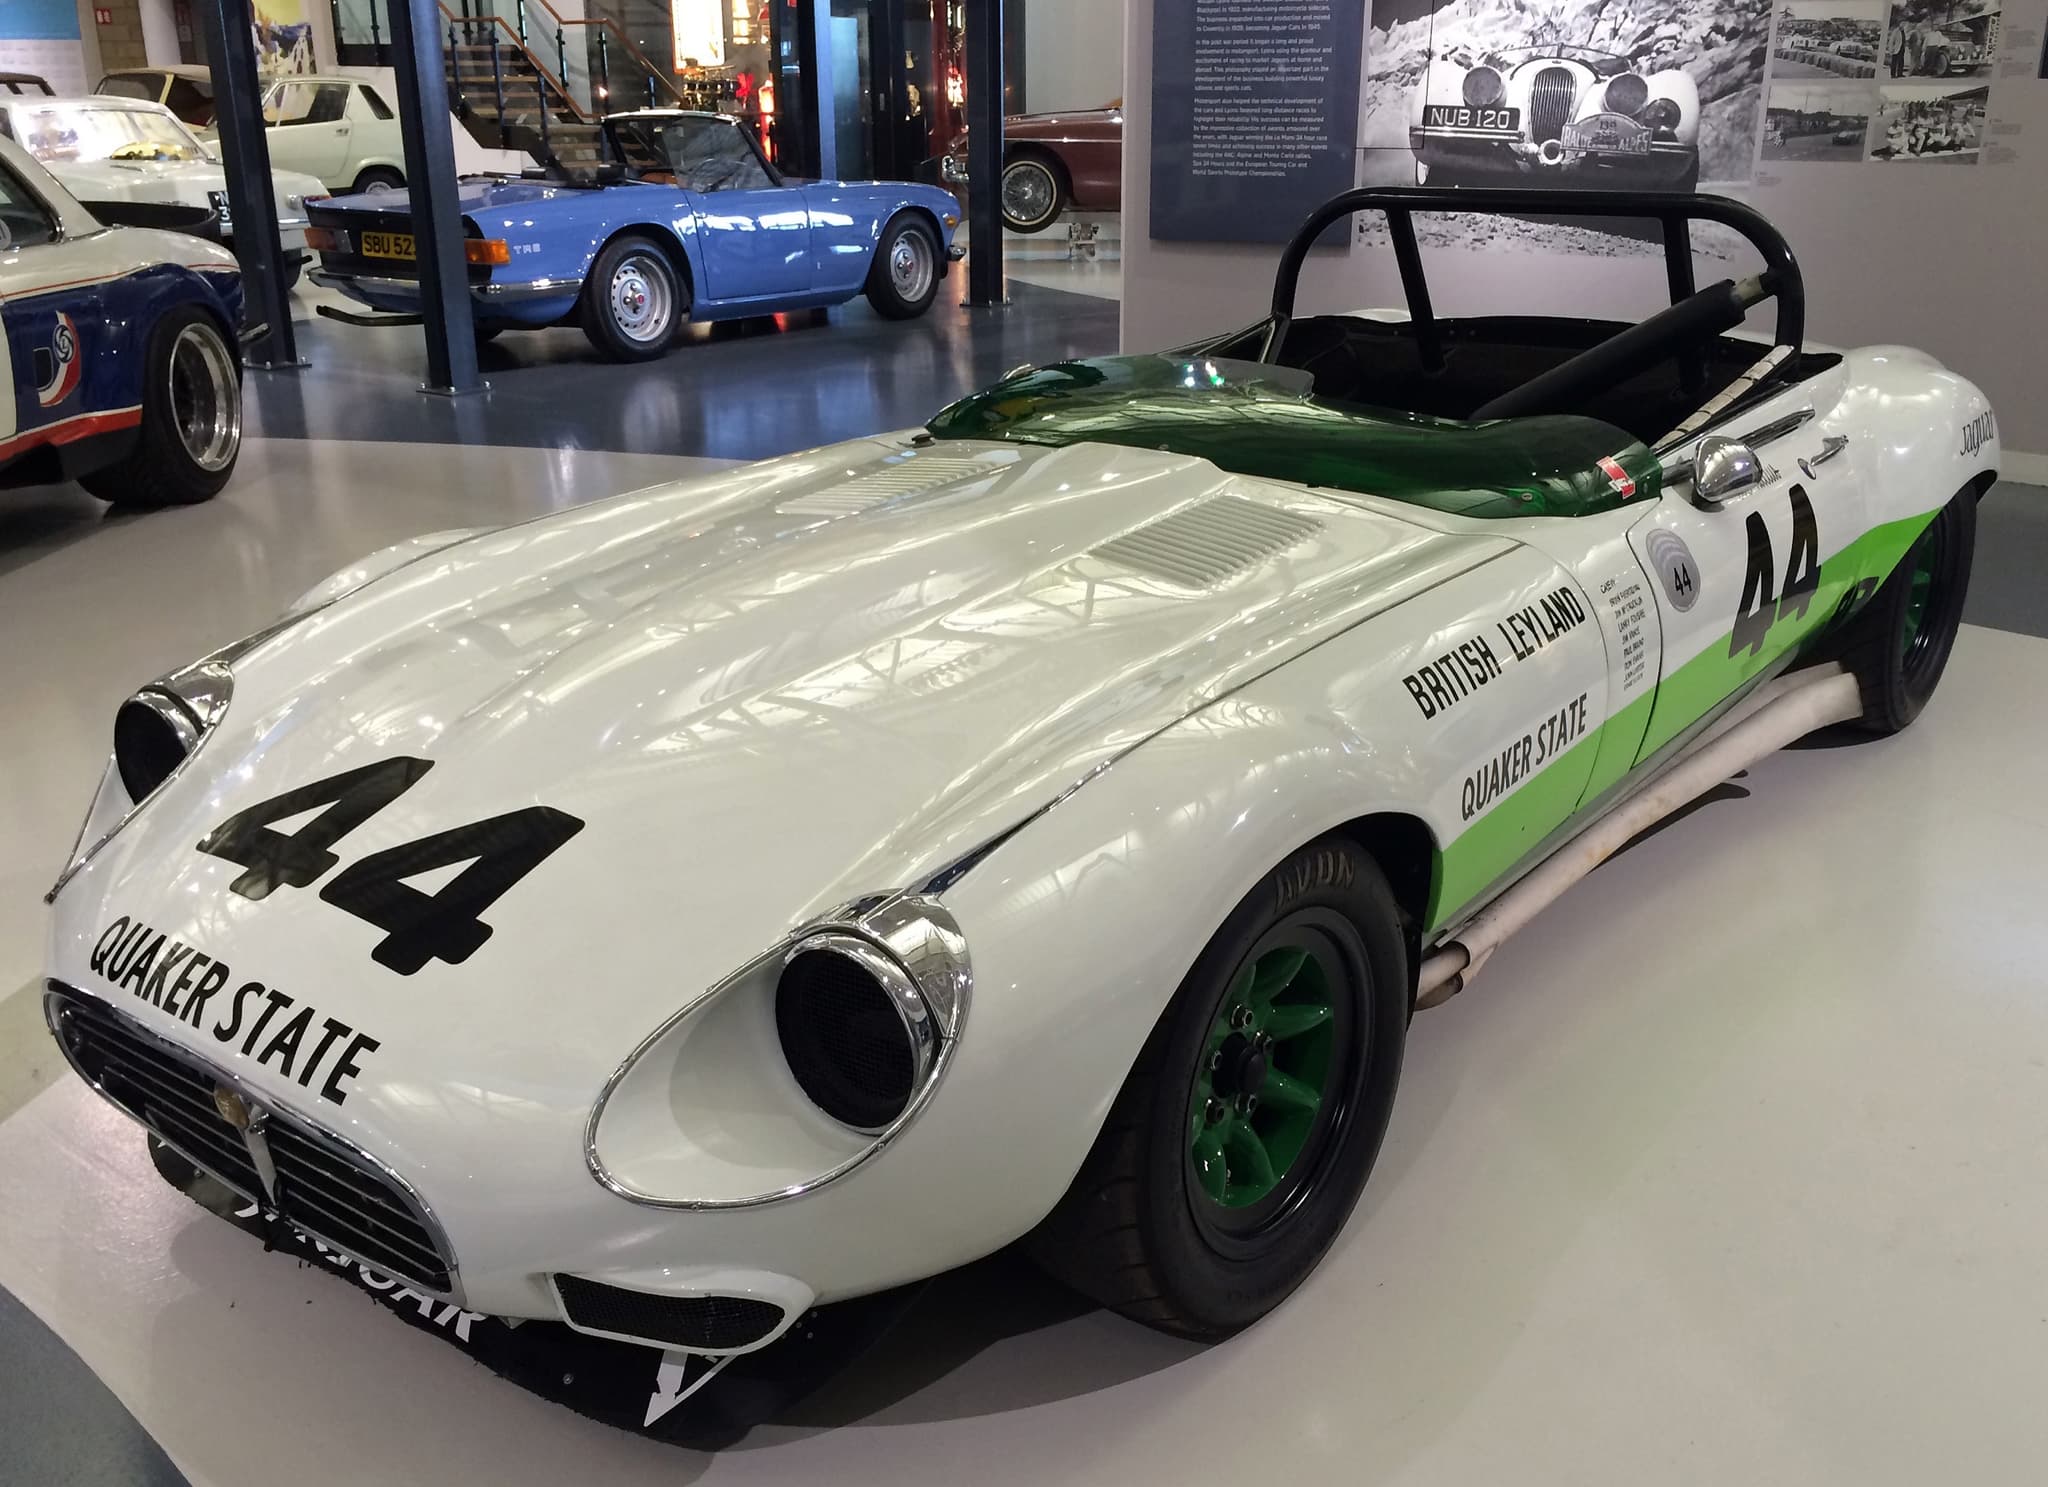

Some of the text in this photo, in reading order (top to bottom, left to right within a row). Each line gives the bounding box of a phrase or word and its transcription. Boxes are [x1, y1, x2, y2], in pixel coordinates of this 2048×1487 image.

[1431, 107, 1510, 129] NUB 120
[364, 233, 416, 257] SBU 52
[1673, 562, 1693, 597] 44
[1729, 483, 1822, 659] 44
[1402, 586, 1586, 721] BRITISH LEYLAND
[1461, 692, 1588, 821] QUAKER STATE
[196, 755, 585, 976] 44
[90, 914, 381, 1106] QUAKER STATE
